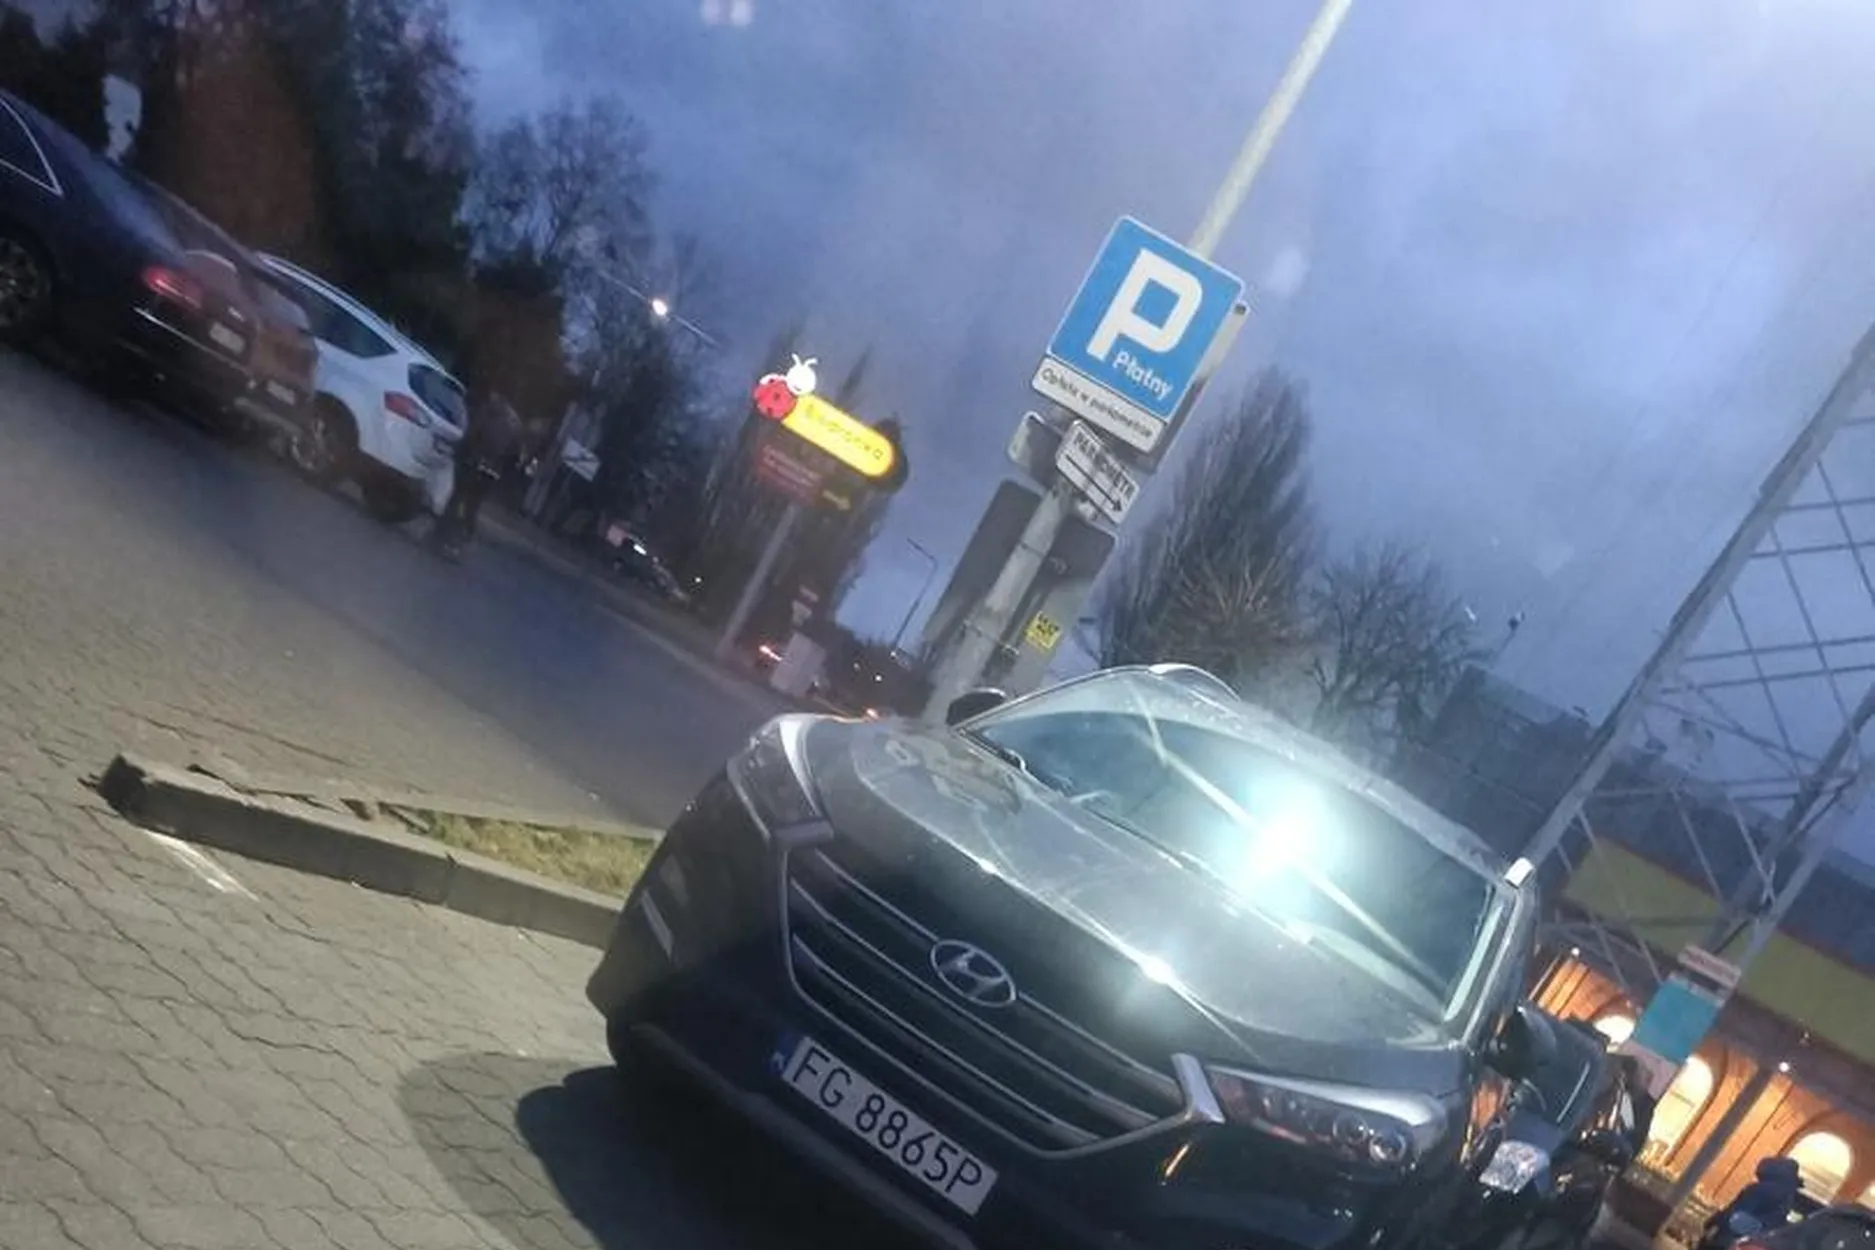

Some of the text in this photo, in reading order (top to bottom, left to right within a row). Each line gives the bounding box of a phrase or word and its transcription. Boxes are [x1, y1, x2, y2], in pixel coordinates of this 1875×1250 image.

[1086, 247, 1203, 362] P
[793, 1046, 983, 1193] FG 8865P
